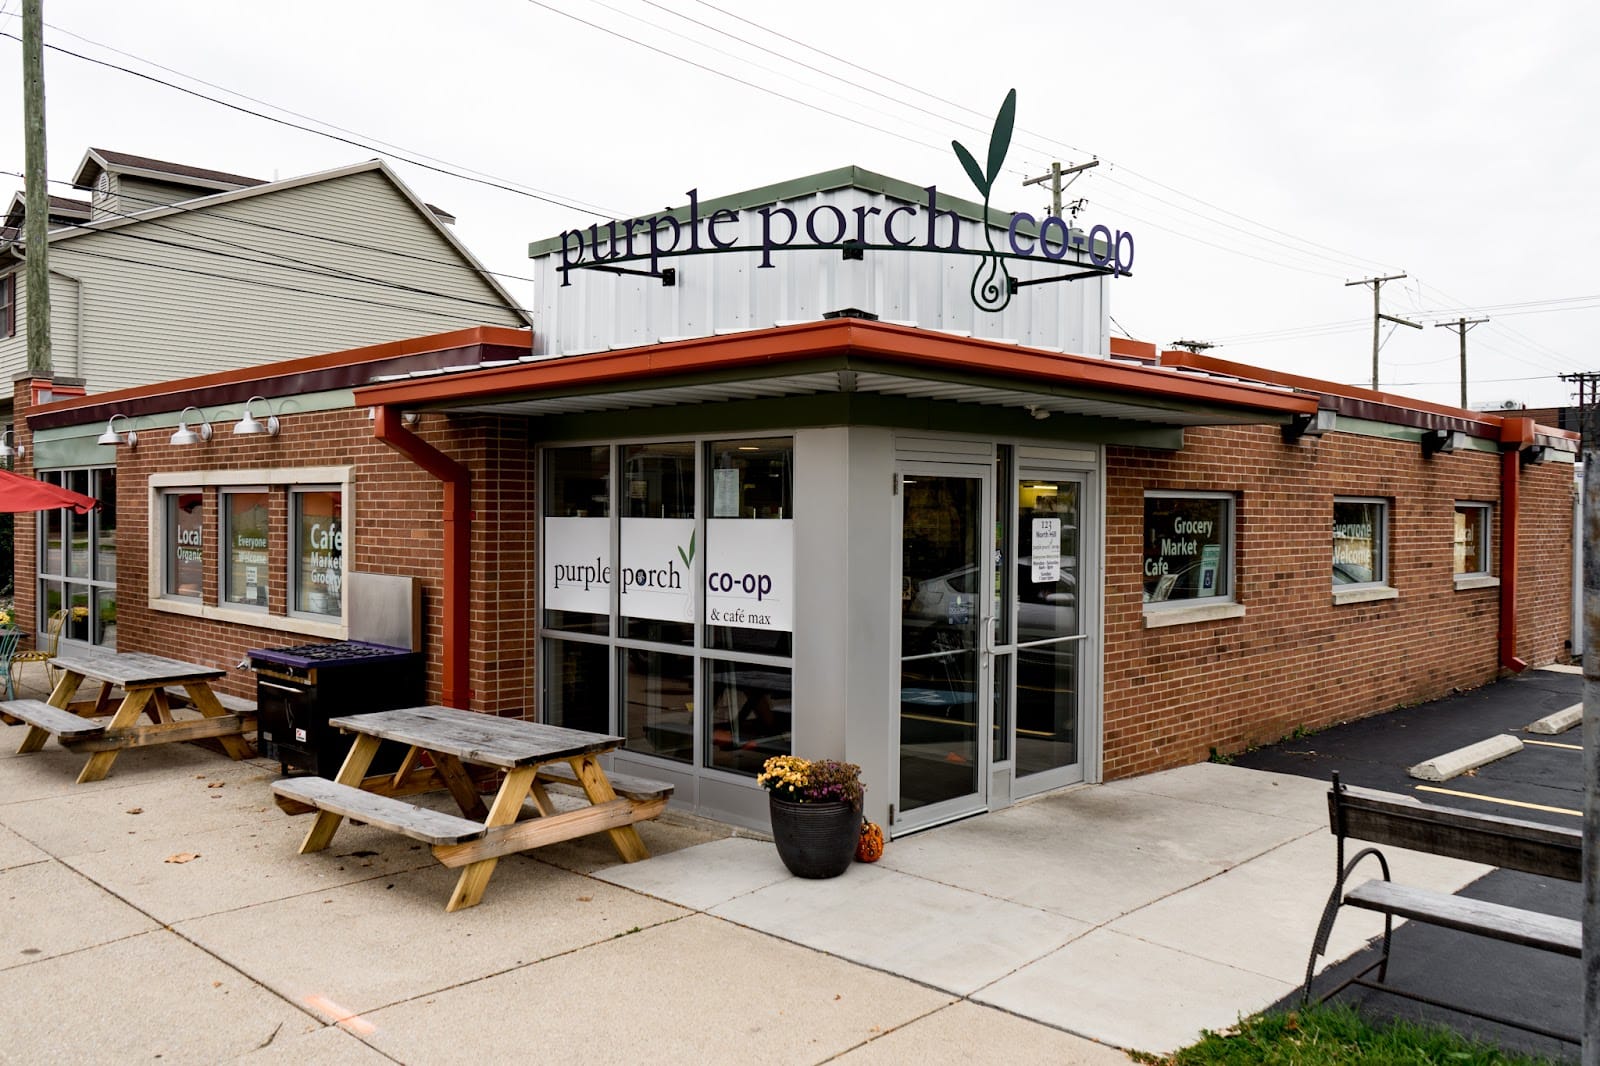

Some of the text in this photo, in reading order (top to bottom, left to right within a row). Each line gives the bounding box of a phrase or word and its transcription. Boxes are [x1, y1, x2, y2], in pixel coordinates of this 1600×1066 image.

[559, 185, 1135, 287] purple porch co-op
[177, 524, 202, 546] Local
[1041, 520, 1052, 532] 123
[1174, 517, 1213, 538] Grocery
[238, 534, 267, 550] Everyone
[310, 523, 342, 550] Cafe
[1161, 537, 1197, 556] Market
[310, 551, 342, 570] Market
[1144, 557, 1169, 576] Cafe
[553, 557, 772, 601] purple porch co-op
[710, 608, 771, 625] & café max
